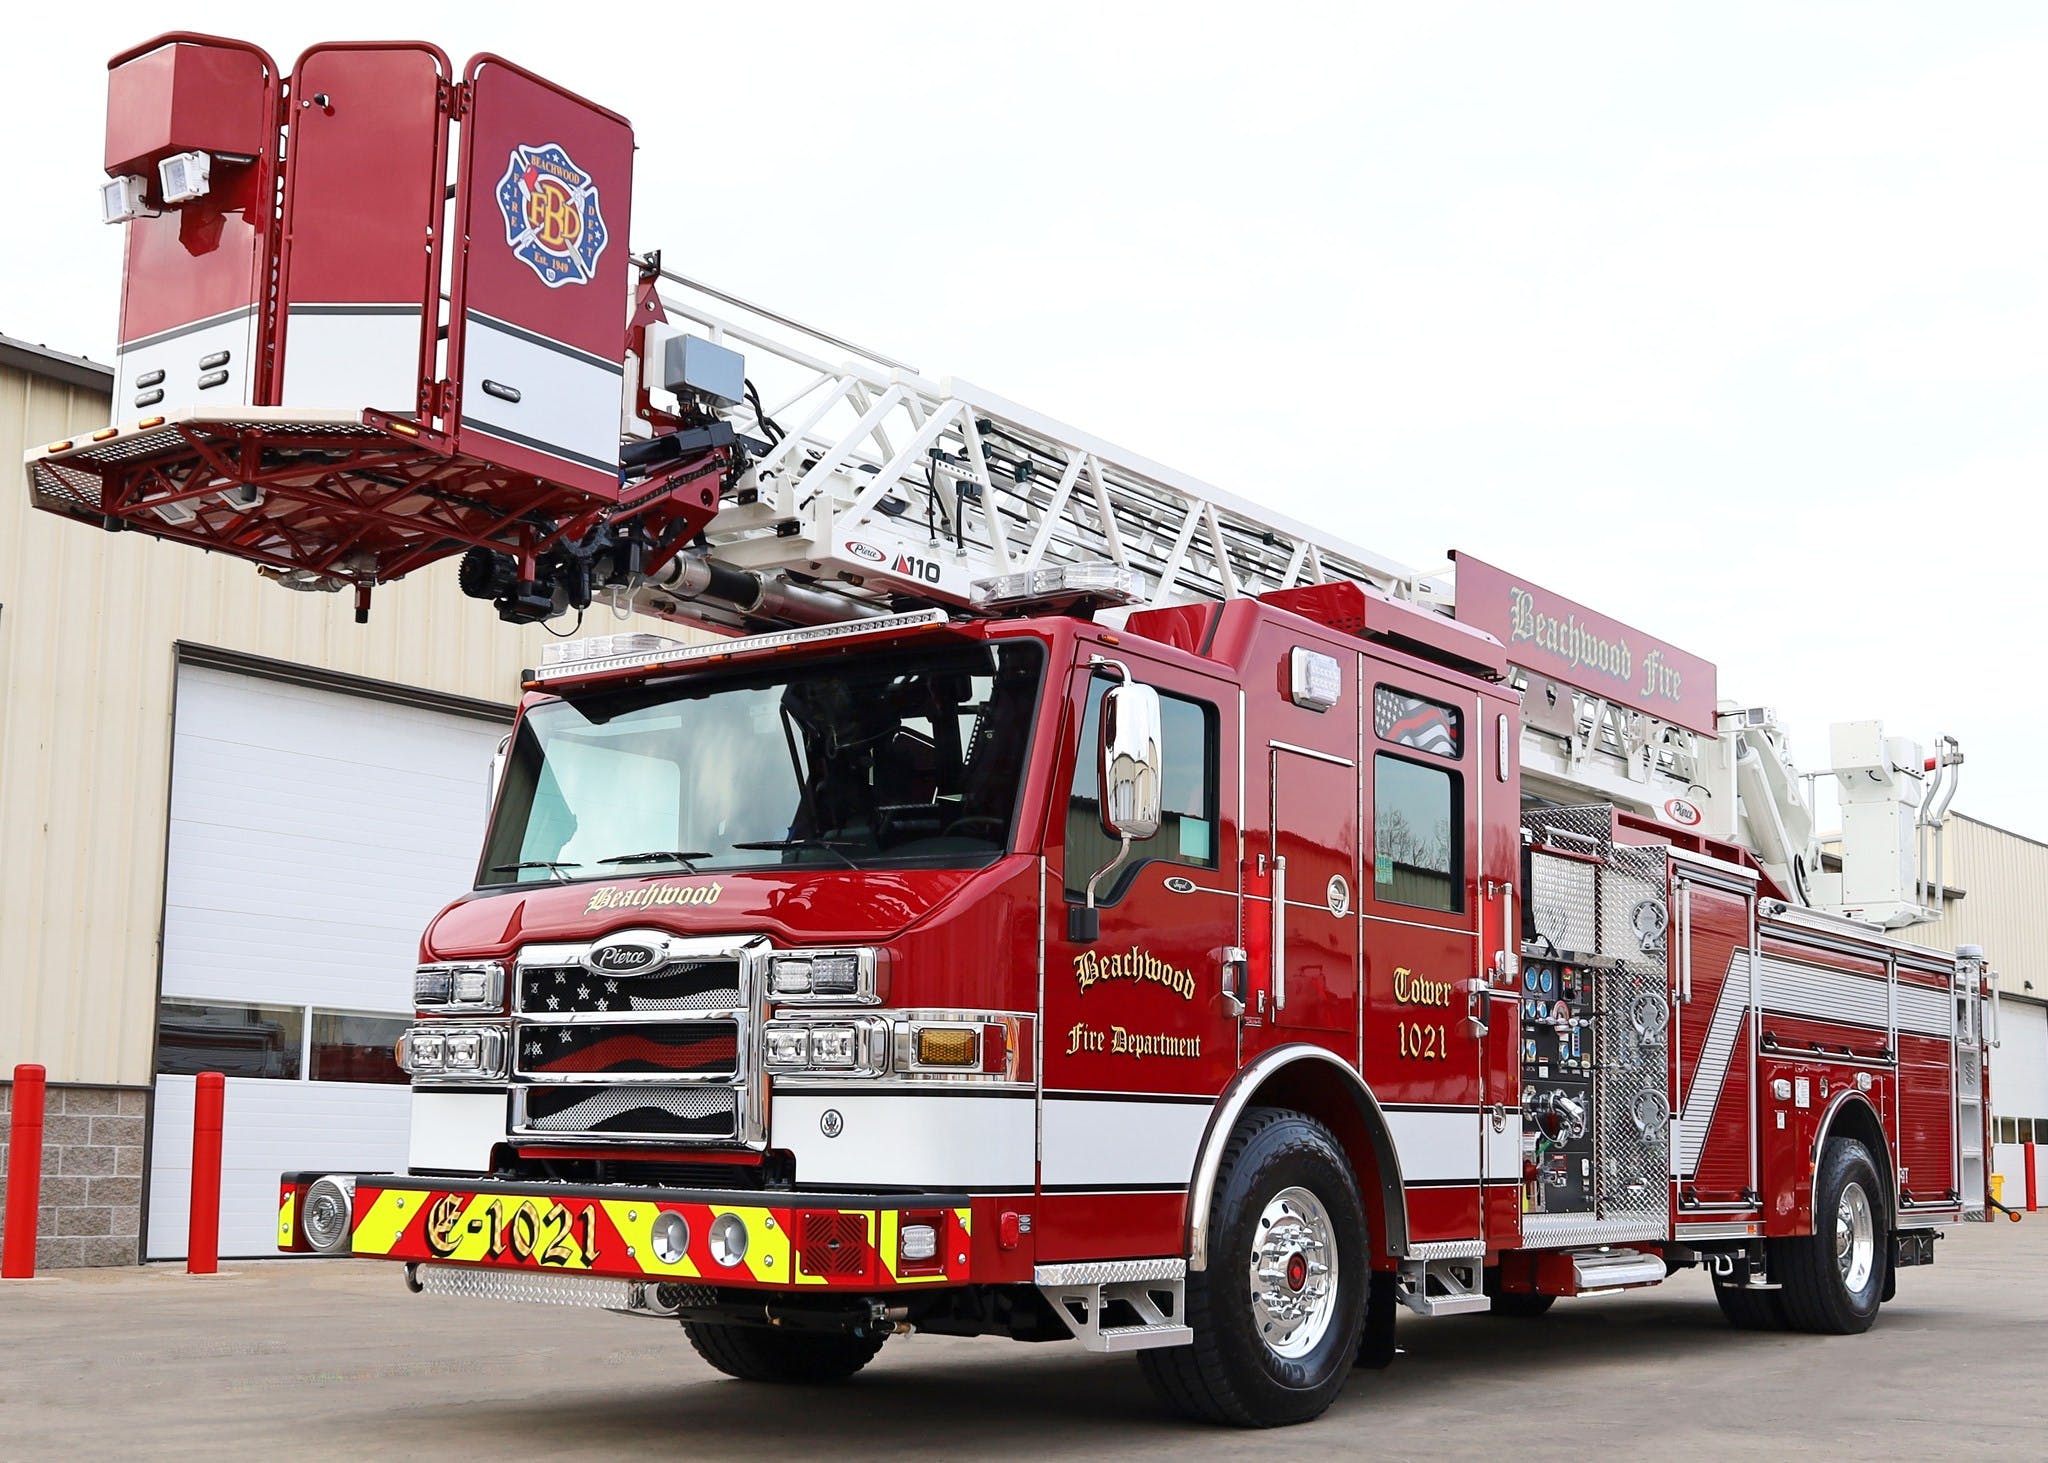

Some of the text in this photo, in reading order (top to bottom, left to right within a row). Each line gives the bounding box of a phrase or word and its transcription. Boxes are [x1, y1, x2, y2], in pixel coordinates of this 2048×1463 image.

[530, 154, 580, 185] BEACHWOOD
[510, 172, 520, 227] FIRE
[587, 205, 595, 258] DEPT
[534, 251, 569, 273] Est. 1949
[854, 544, 878, 558] Pierce
[1510, 586, 1682, 701] Beachwood Fire
[1673, 801, 1694, 820] Pierce
[583, 881, 724, 916] Beachwood
[599, 946, 647, 969] Pierce
[1072, 945, 1197, 1001] Beachwood
[1393, 967, 1452, 1007] Tower
[1065, 1022, 1201, 1059] Fire Department
[1398, 1021, 1448, 1059] 1021
[426, 1193, 601, 1268] E-1021
